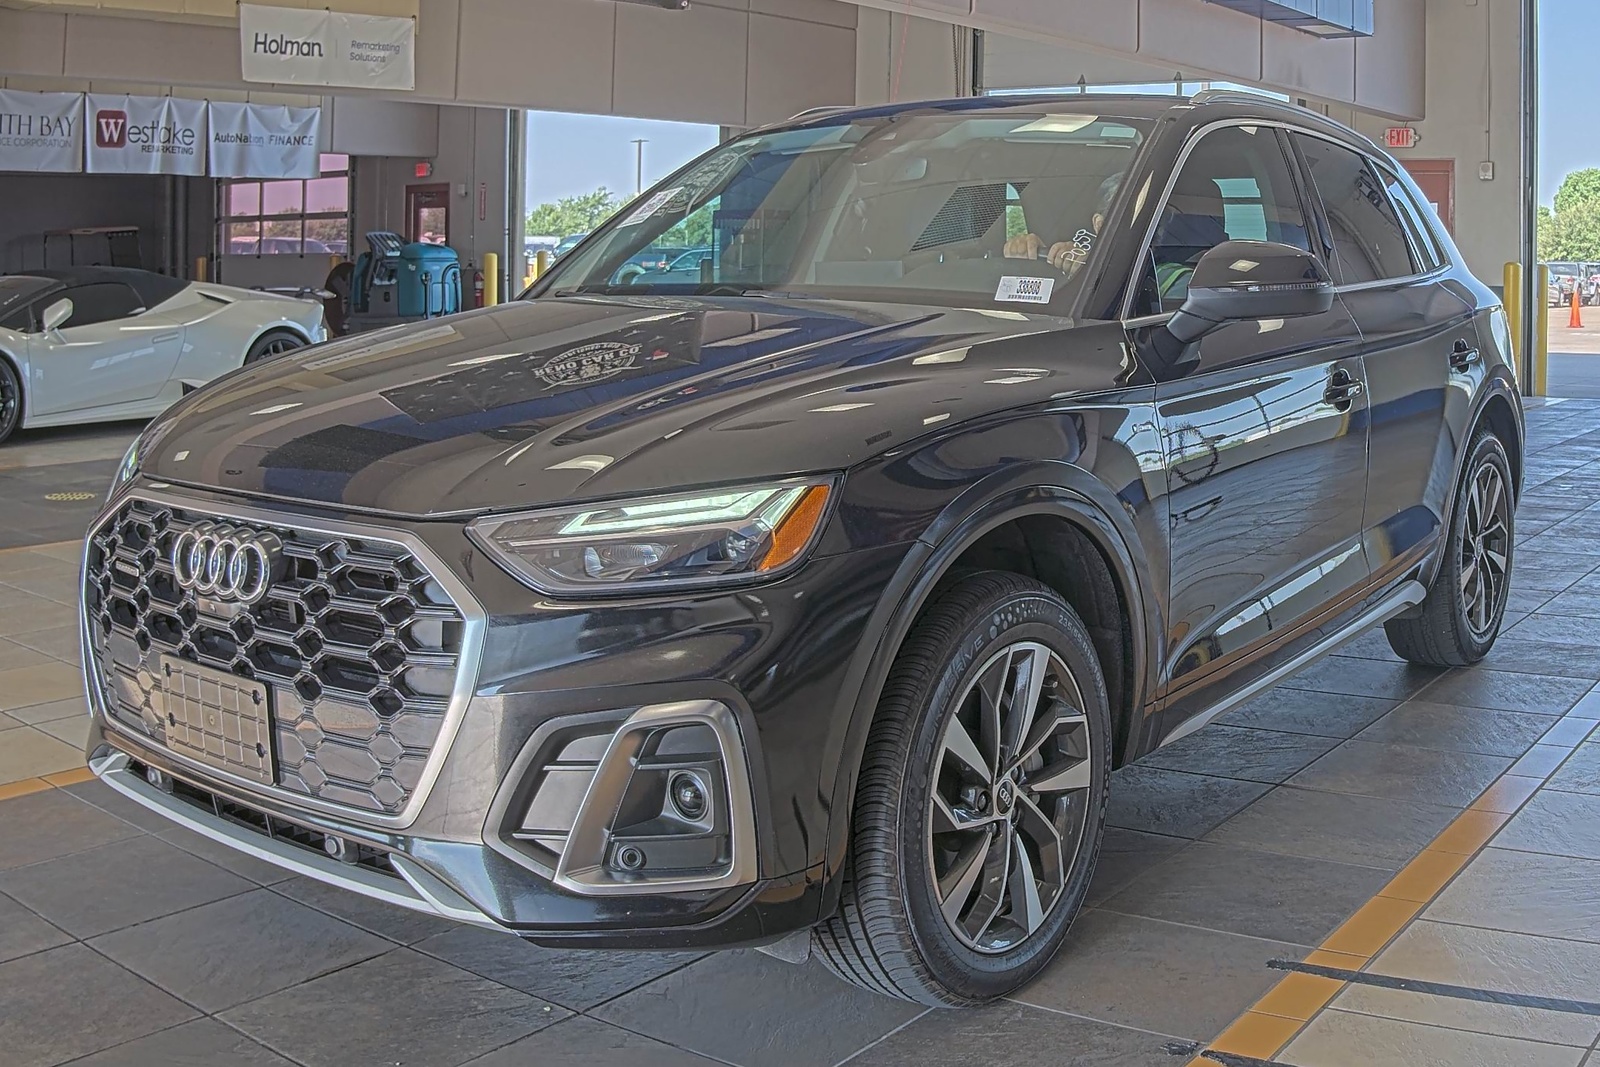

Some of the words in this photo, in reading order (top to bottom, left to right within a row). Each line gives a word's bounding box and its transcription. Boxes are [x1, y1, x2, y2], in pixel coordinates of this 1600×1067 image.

[254, 32, 323, 57] Holman
[351, 40, 400, 55] Remarketing
[350, 52, 386, 63] Solutions
[41, 115, 76, 137] BAY
[99, 118, 195, 146] Westlake
[14, 137, 73, 149] CORPORATION
[214, 132, 264, 145] AutoNation
[269, 134, 314, 146] FINANCE
[1389, 129, 1410, 146] EXIT
